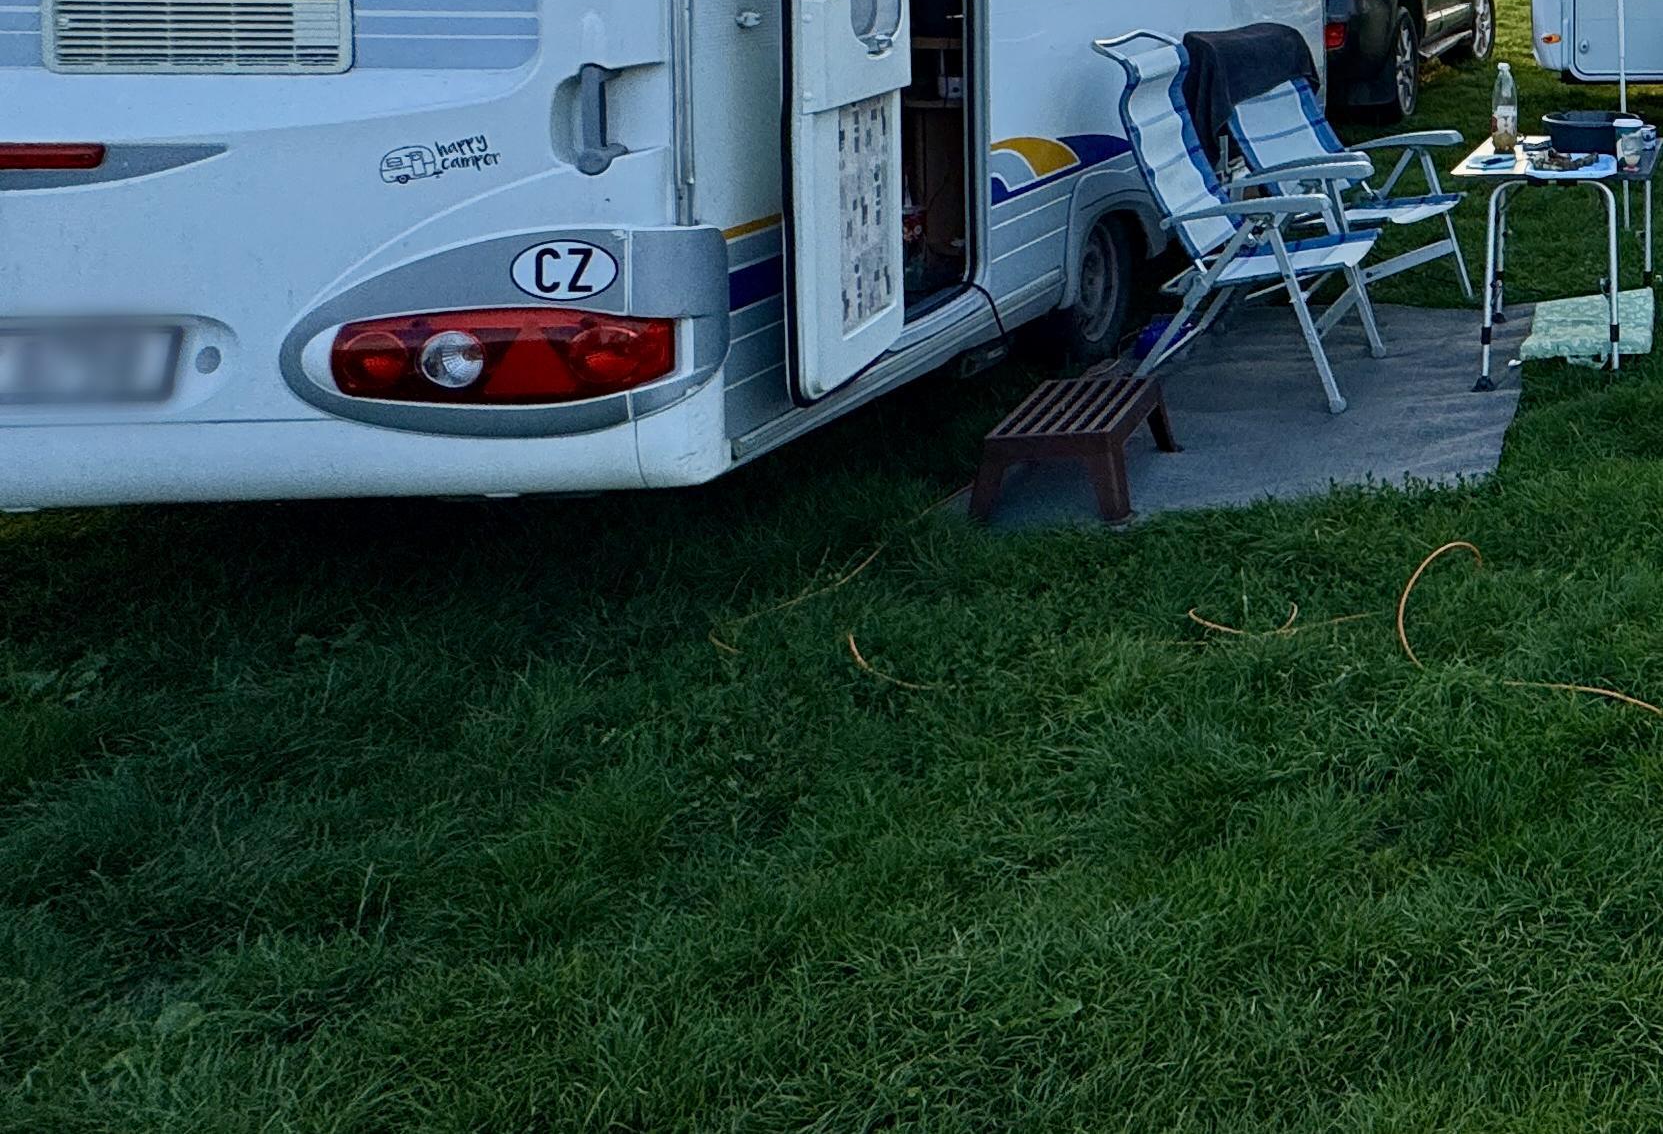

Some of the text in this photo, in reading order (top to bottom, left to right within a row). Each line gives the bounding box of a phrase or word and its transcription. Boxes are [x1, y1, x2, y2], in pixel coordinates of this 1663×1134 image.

[435, 135, 488, 157] happy
[441, 152, 501, 171] camper
[535, 247, 593, 293] CZ
